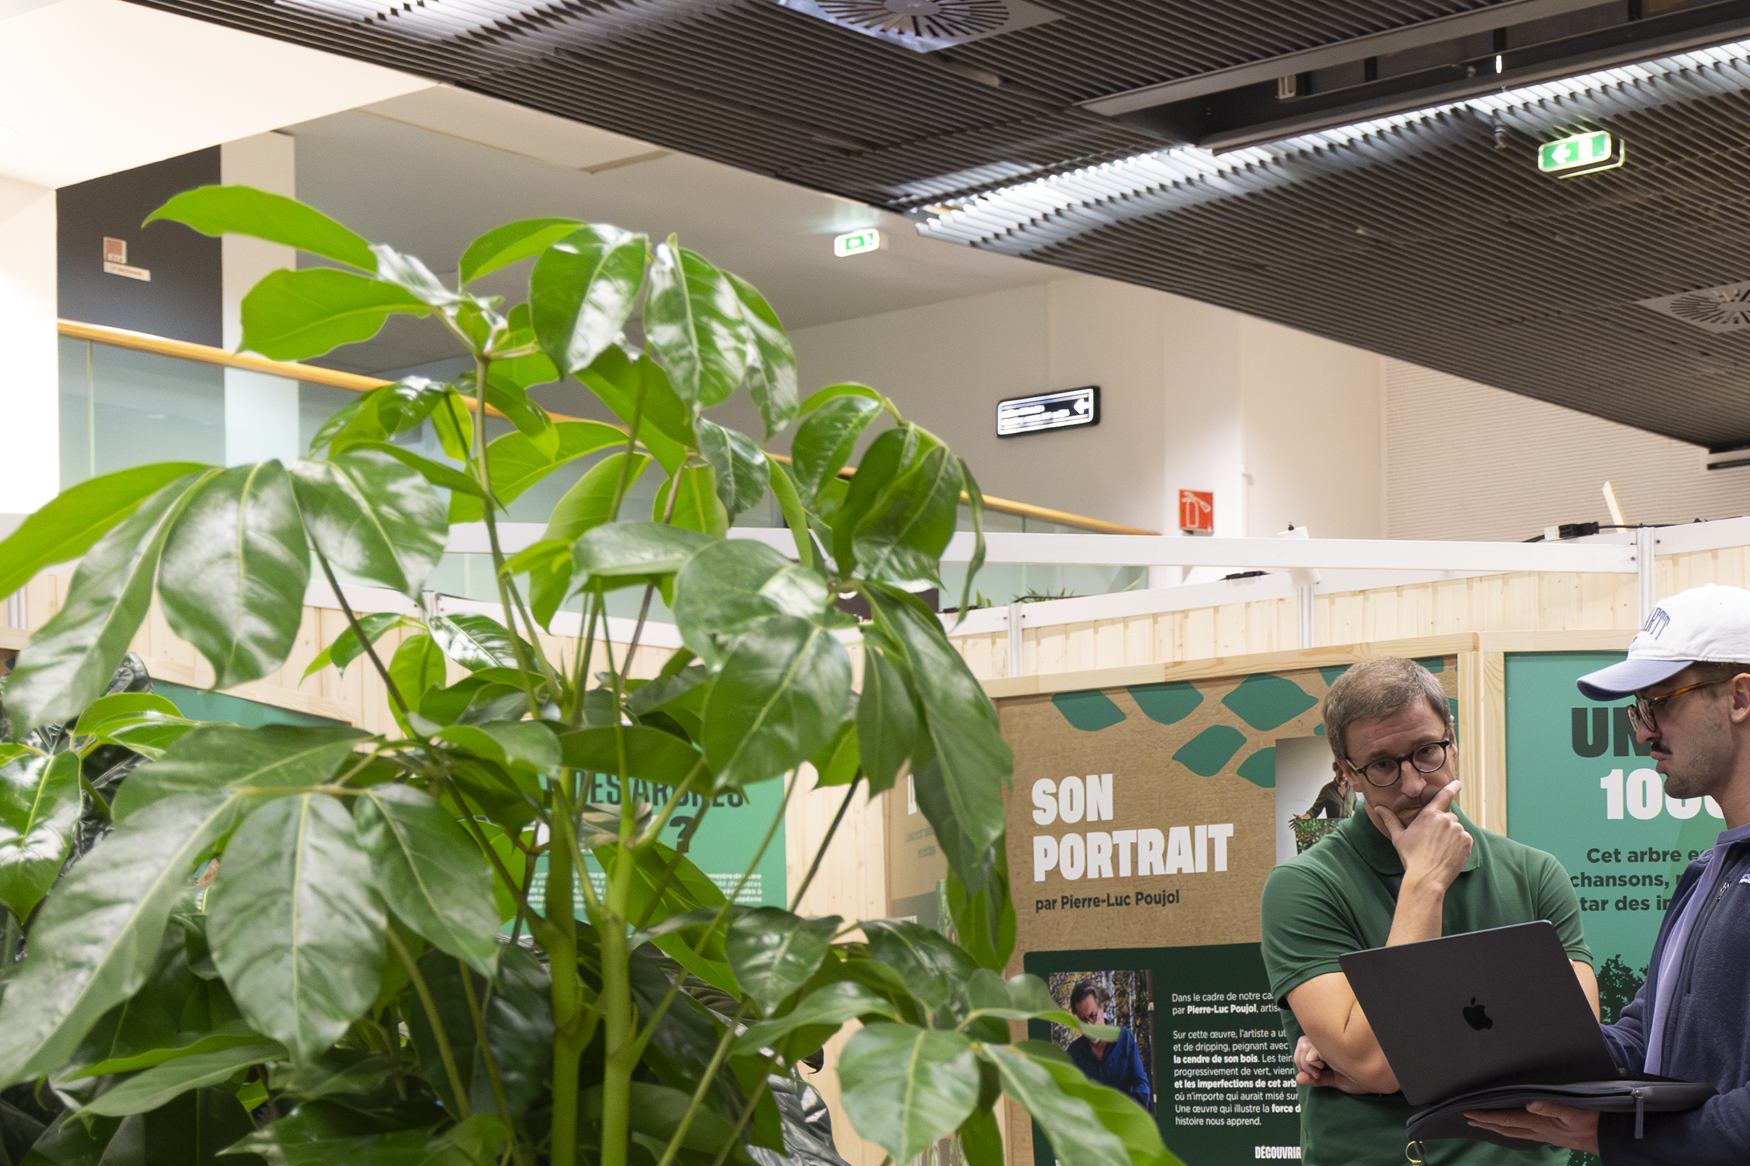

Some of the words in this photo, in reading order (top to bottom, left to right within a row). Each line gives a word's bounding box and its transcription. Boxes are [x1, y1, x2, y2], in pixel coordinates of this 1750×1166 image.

[1032, 773, 1114, 826] SON
[1033, 823, 1234, 882] PORTRAIT
[1587, 848, 1621, 863] Cet
[1627, 847, 1682, 863] arbre
[1570, 872, 1669, 890] chansons,
[1035, 899, 1057, 914] par
[1061, 893, 1131, 910] Pierre-Luc
[1135, 889, 1180, 907] Poujol
[1580, 897, 1609, 912] tar
[1614, 895, 1650, 911] des
[1172, 1007, 1185, 1016] par
[1187, 1004, 1229, 1014] Pierre-Luc
[1230, 1004, 1258, 1014] Poujol,
[1173, 1055, 1182, 1064] la
[1182, 1055, 1210, 1064] cendre
[1211, 1054, 1222, 1063] de
[1240, 1054, 1260, 1063] bois.
[1262, 1054, 1276, 1063] Les
[1175, 1117, 1204, 1126] histoire
[1226, 1117, 1262, 1127] apprend.
